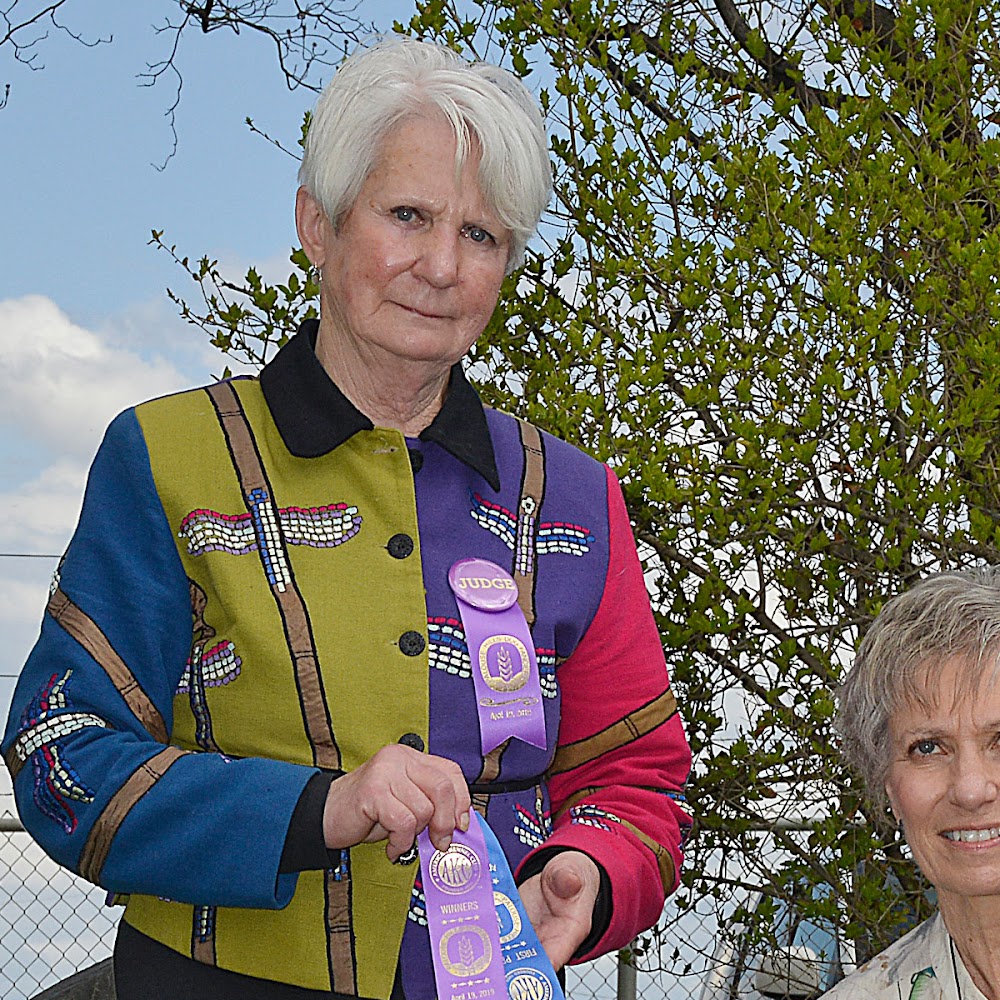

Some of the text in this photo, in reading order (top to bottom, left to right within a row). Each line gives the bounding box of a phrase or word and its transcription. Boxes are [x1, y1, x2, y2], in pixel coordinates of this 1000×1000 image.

[458, 577, 516, 591] JUDGE
[442, 857, 472, 884] AKC
[440, 901, 479, 915] WINNERS
[515, 948, 538, 961] FIRST
[467, 991, 477, 1000] 19,
[479, 988, 495, 998] 2019
